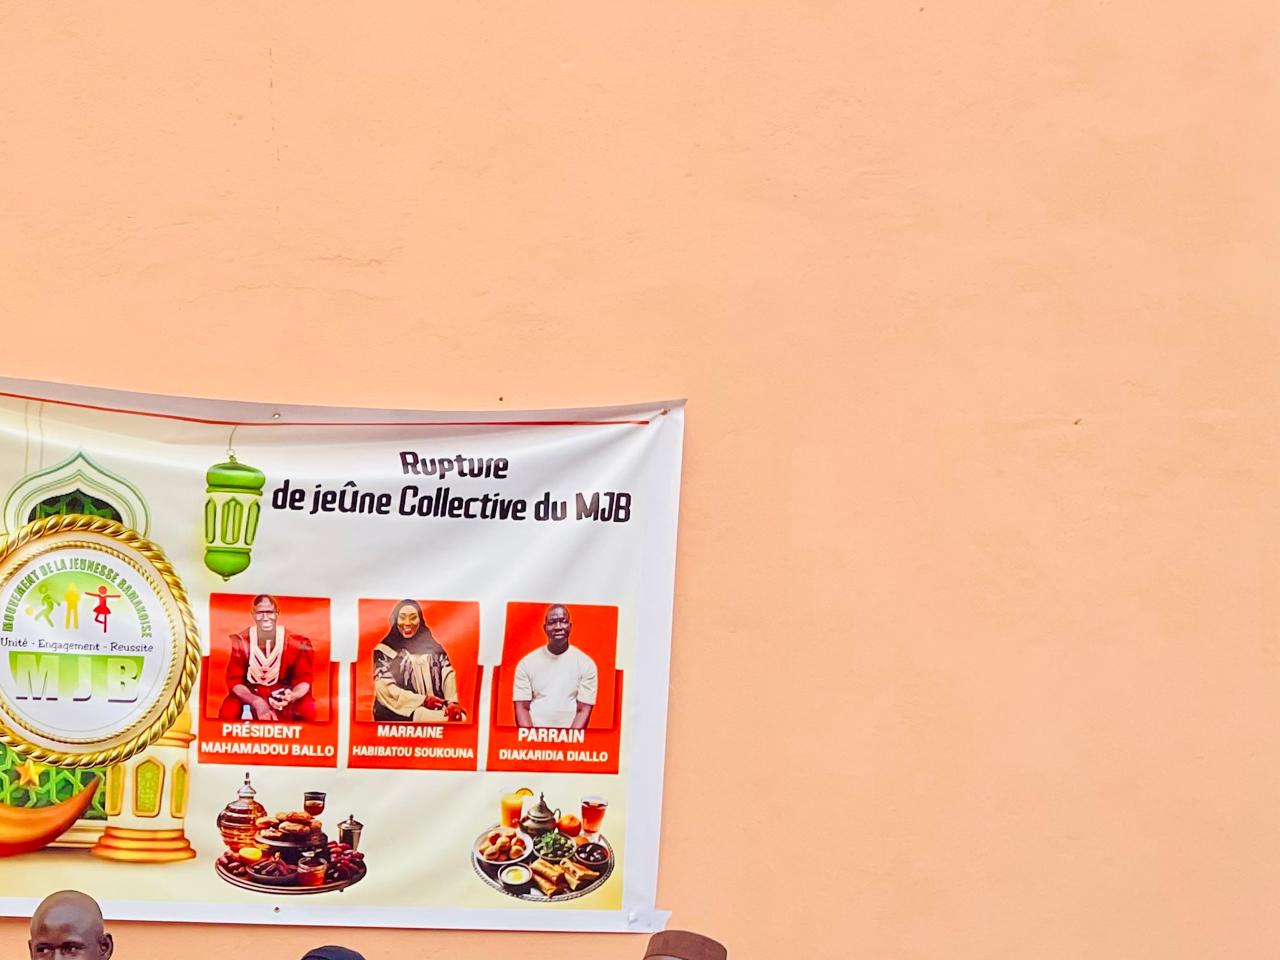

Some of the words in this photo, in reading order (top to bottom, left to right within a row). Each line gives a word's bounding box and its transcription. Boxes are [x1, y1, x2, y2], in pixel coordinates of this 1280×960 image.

[399, 451, 508, 479] Rupture
[272, 479, 305, 510] de
[310, 481, 391, 515] jeûne
[399, 485, 526, 521] Collective
[534, 492, 567, 521] du
[576, 492, 631, 522] MJB
[2, 569, 39, 632] MOUVEMENT
[39, 562, 54, 576] DE
[54, 560, 67, 571] LA
[70, 558, 119, 583] JEUNESSE
[0, 637, 28, 648] Unité
[38, 639, 100, 652] Engagement
[16, 653, 138, 703] MJB
[222, 721, 302, 739] PRÉSIDENT
[377, 725, 444, 739] MARRAINE
[518, 727, 585, 744] PARRAIN
[201, 742, 289, 755] MAHAMADOU
[291, 745, 334, 757] BALLO
[352, 745, 412, 757] HABIBATOU
[414, 747, 473, 758] SOUKOUNA
[499, 749, 565, 761] DIAKARIDIA
[566, 751, 608, 762] DIALLO
